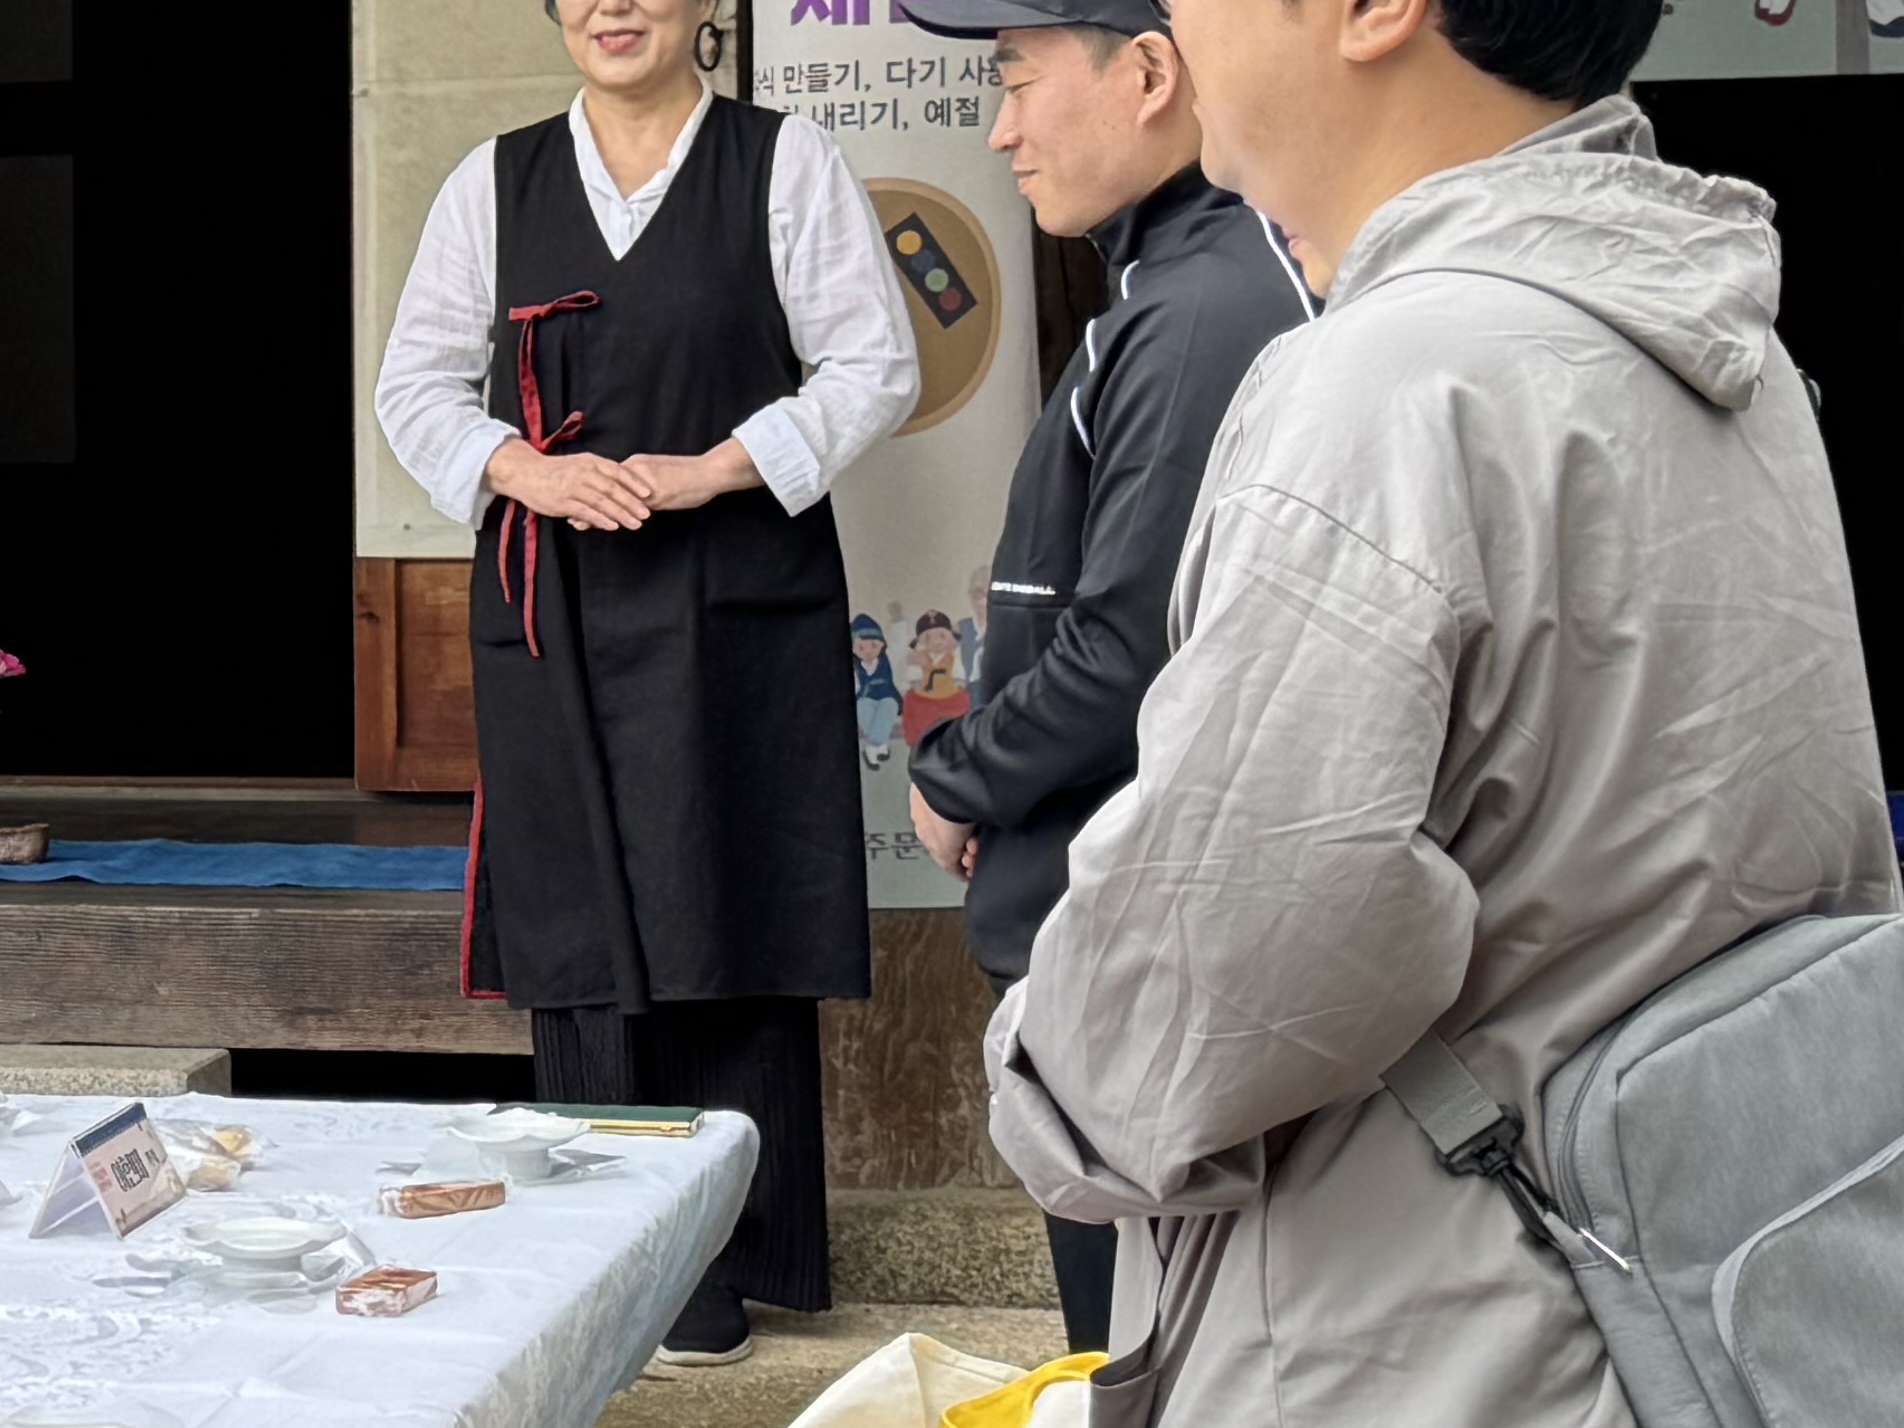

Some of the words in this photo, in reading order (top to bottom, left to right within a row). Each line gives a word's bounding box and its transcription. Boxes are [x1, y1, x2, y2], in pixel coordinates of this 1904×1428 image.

[783, 59, 872, 93] 만들기,
[886, 56, 946, 88] 다기
[811, 97, 909, 133] 내리기,
[924, 96, 980, 128] 예절
